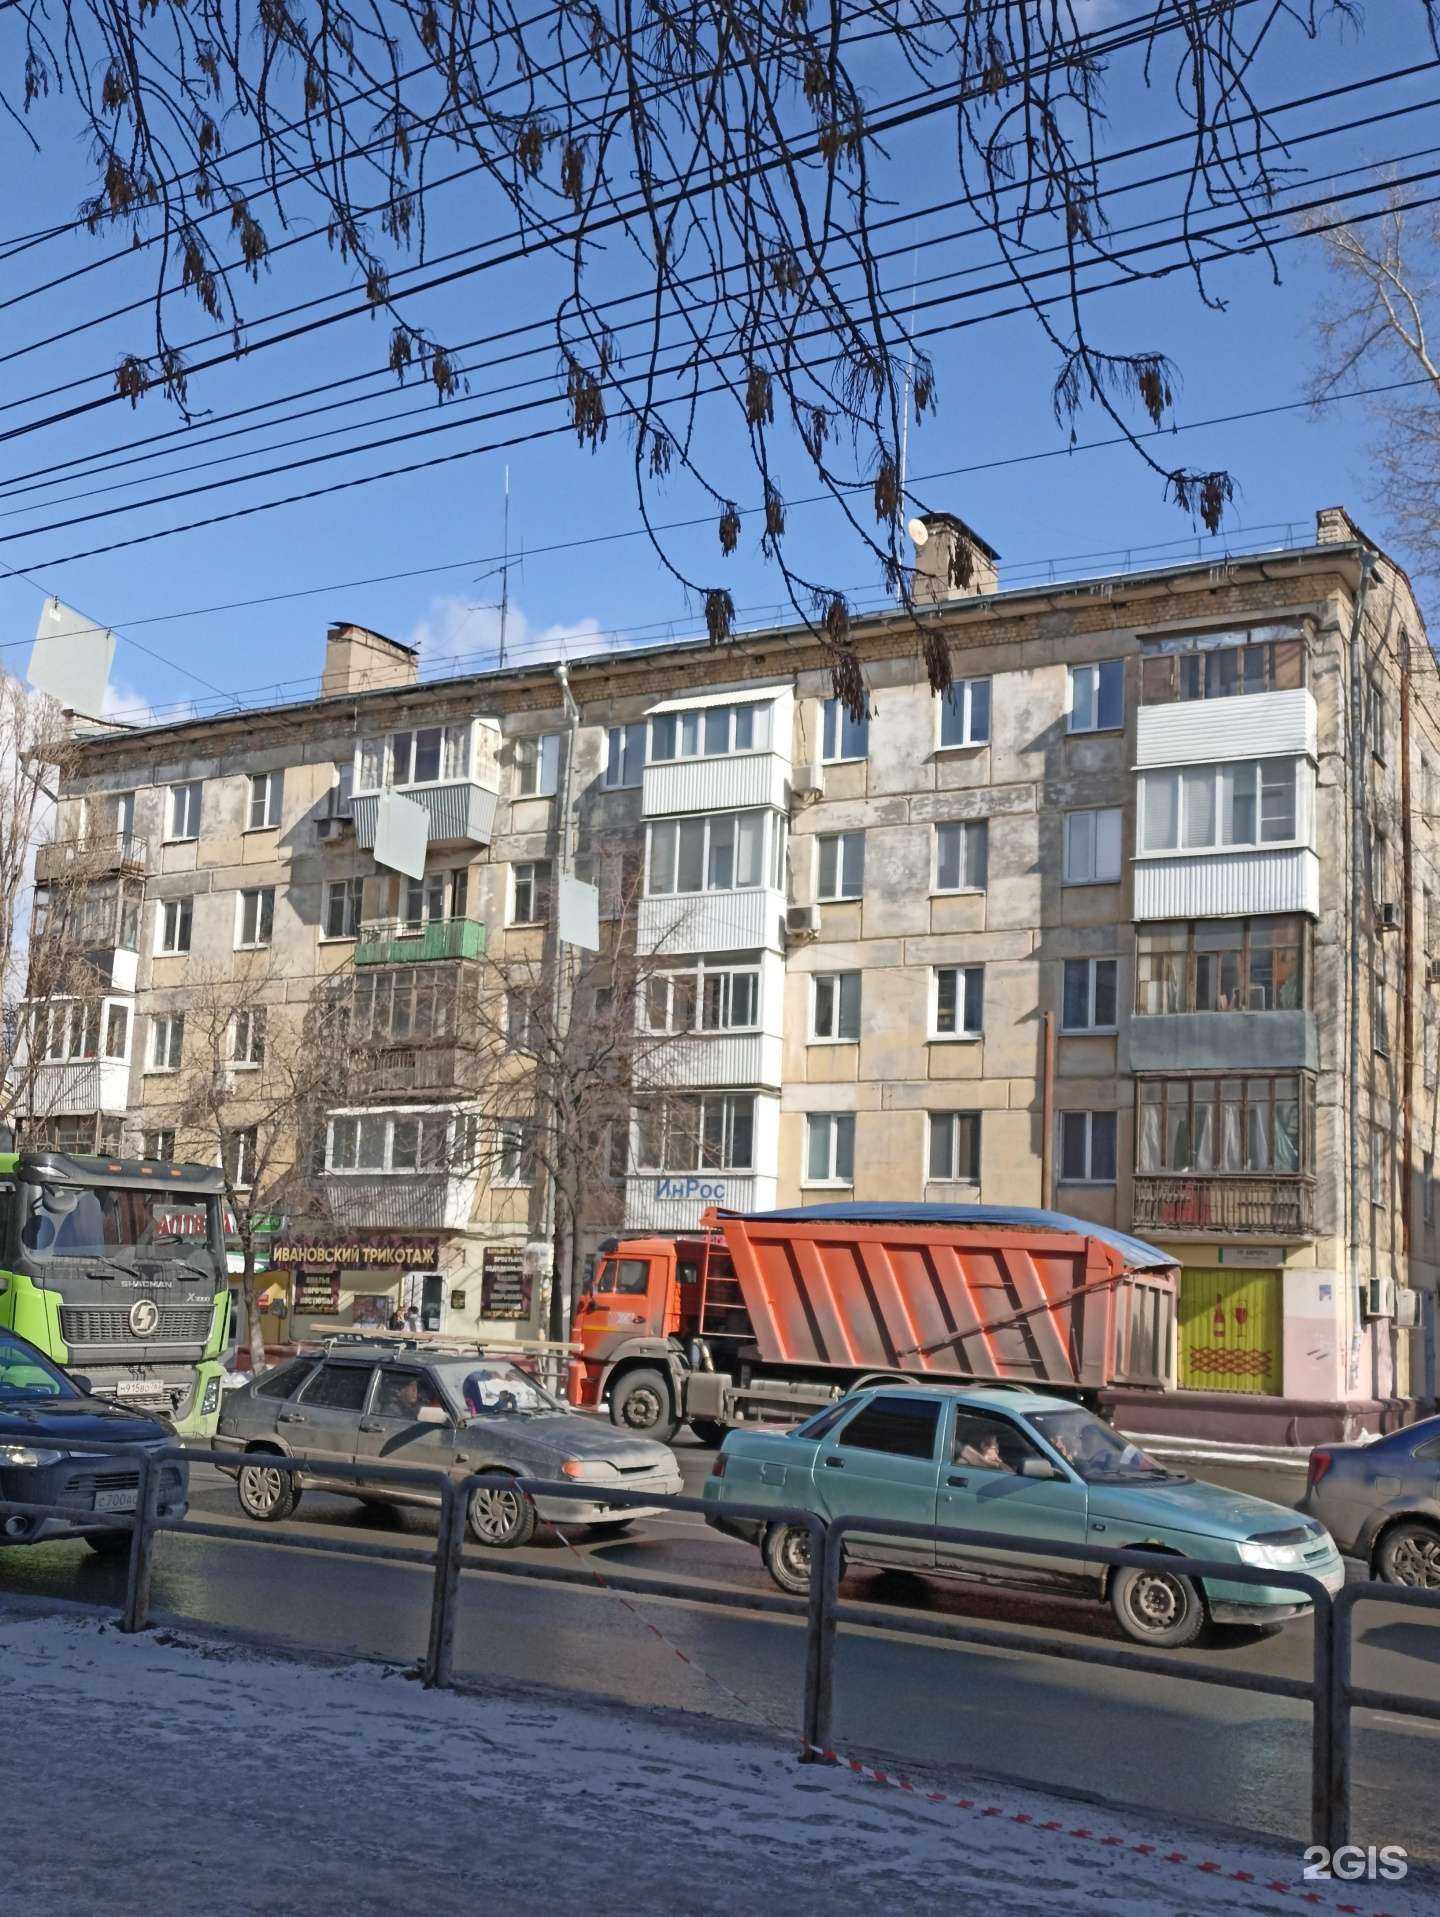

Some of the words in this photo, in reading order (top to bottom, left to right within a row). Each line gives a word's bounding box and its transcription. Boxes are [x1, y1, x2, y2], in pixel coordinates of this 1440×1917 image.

[656, 1178, 725, 1199] ИнРос
[273, 1245, 360, 1263] ИВАНОВСКИЙ
[363, 1248, 435, 1264] ТРИКОТАЖ
[121, 1281, 173, 1289] SHACMAN
